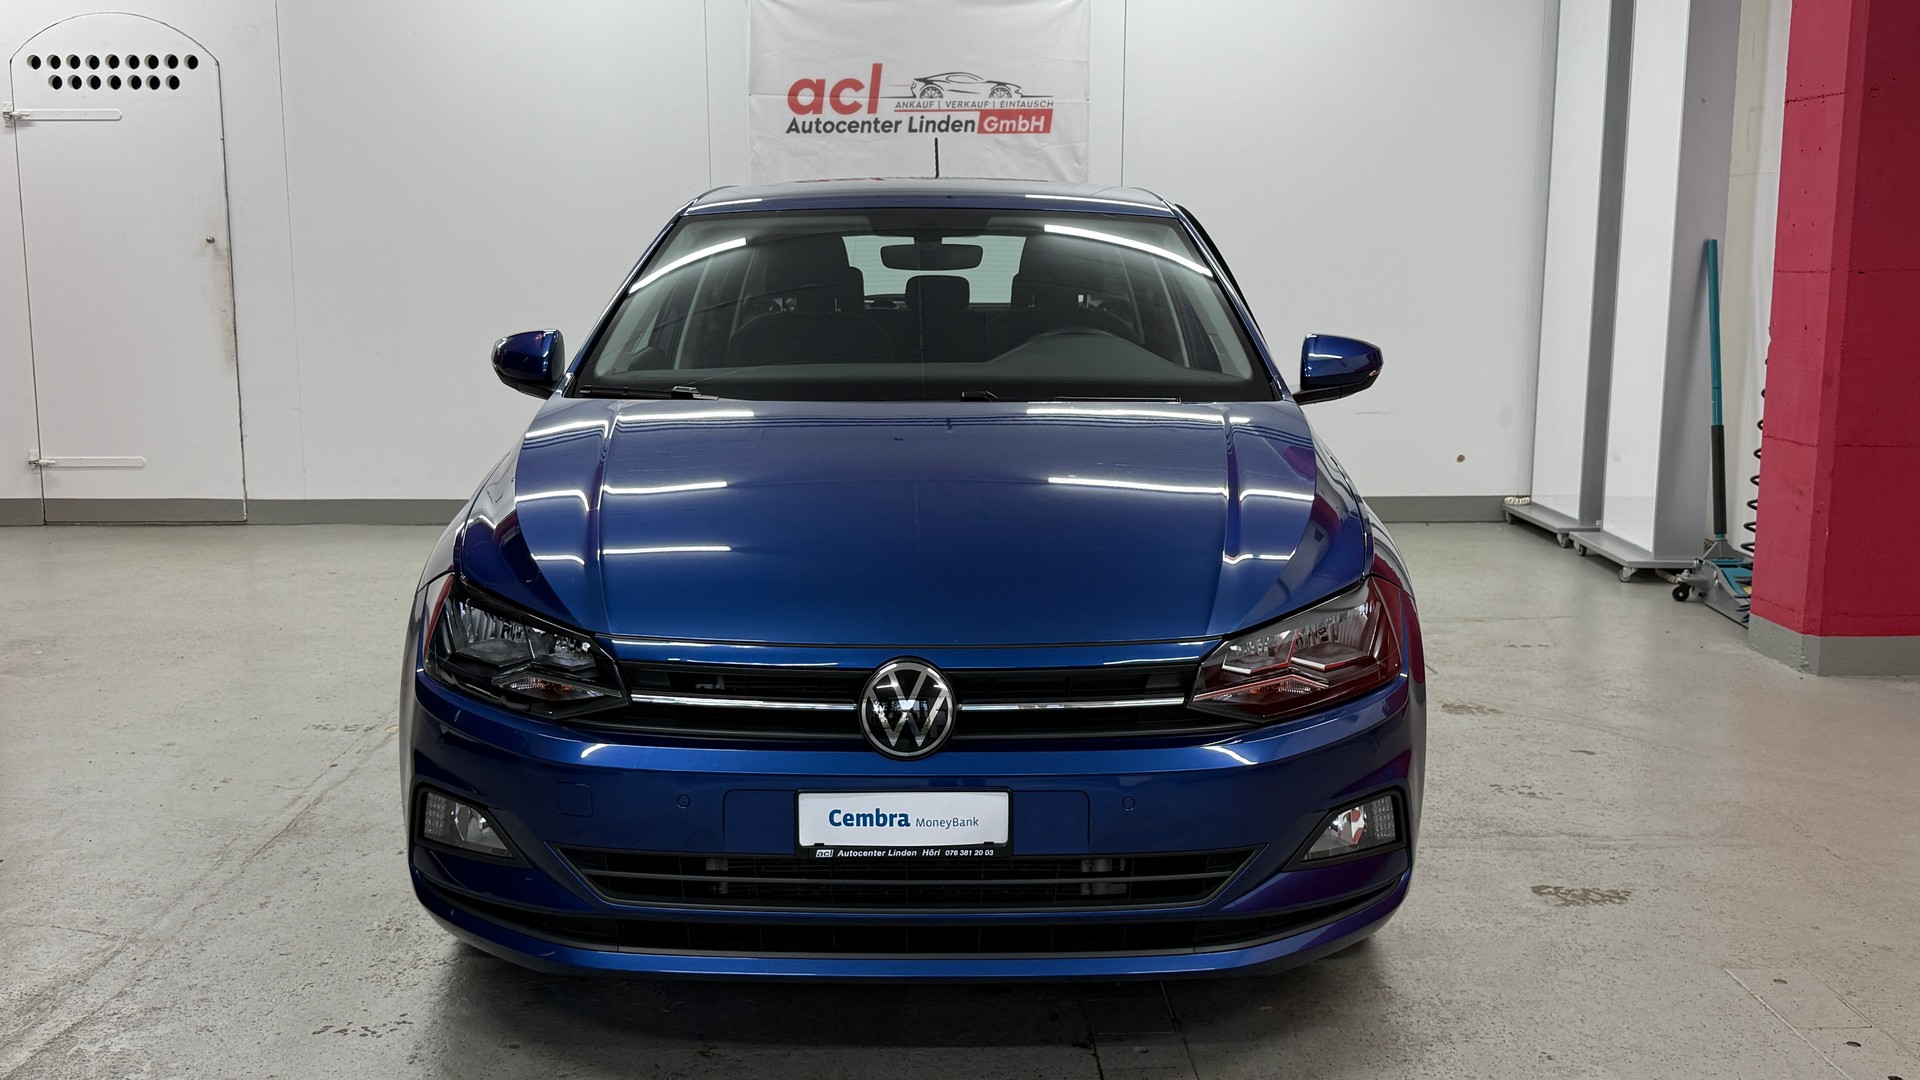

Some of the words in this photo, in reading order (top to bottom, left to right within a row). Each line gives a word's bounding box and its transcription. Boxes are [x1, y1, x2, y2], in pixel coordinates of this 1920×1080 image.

[787, 63, 883, 115] acl
[895, 100, 935, 109] ANKAUF
[946, 100, 990, 109] VERKAUF
[999, 100, 1054, 109] EINTAUSCH
[786, 117, 902, 134] Autocenter
[908, 115, 976, 133] Linden
[983, 116, 1045, 132] GmbH
[828, 808, 911, 827] Cembra
[915, 817, 979, 829] MoneyBank
[837, 849, 887, 857] Autocenter
[888, 849, 917, 857] Linden
[922, 848, 941, 857] Höri
[945, 849, 959, 857] 076
[959, 849, 973, 857] 381
[974, 849, 984, 857] 20
[984, 849, 994, 857] 03
